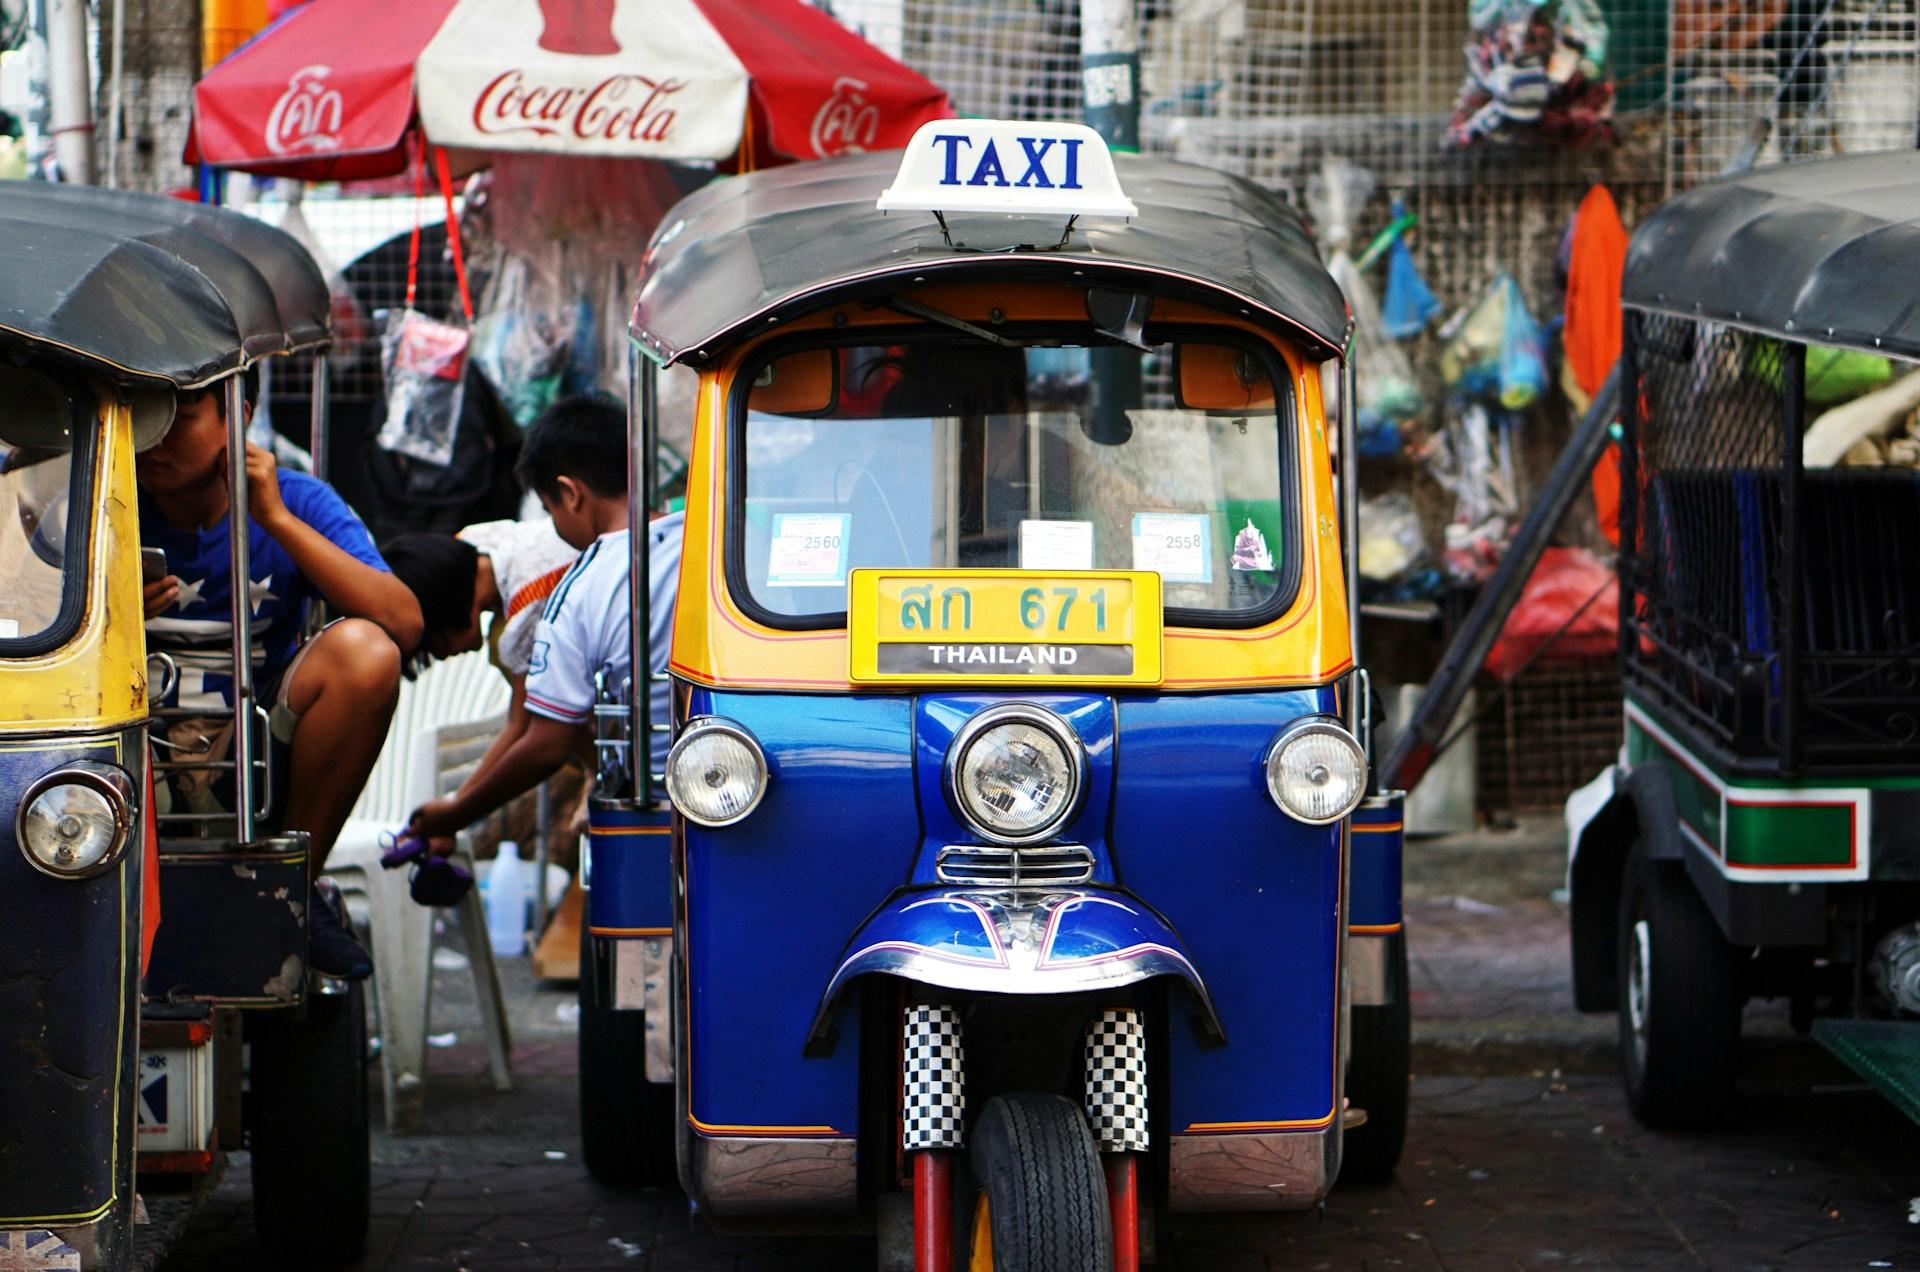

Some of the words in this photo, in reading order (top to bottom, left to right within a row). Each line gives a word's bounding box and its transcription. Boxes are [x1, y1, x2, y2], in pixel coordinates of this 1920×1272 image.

[472, 68, 690, 142] Coca-Cola
[931, 134, 1084, 190] TAXI
[804, 535, 841, 549] 2560
[1165, 534, 1202, 549] 2558
[899, 582, 972, 631] สก
[1019, 586, 1107, 632] 671
[927, 645, 1078, 665] THAILAND
